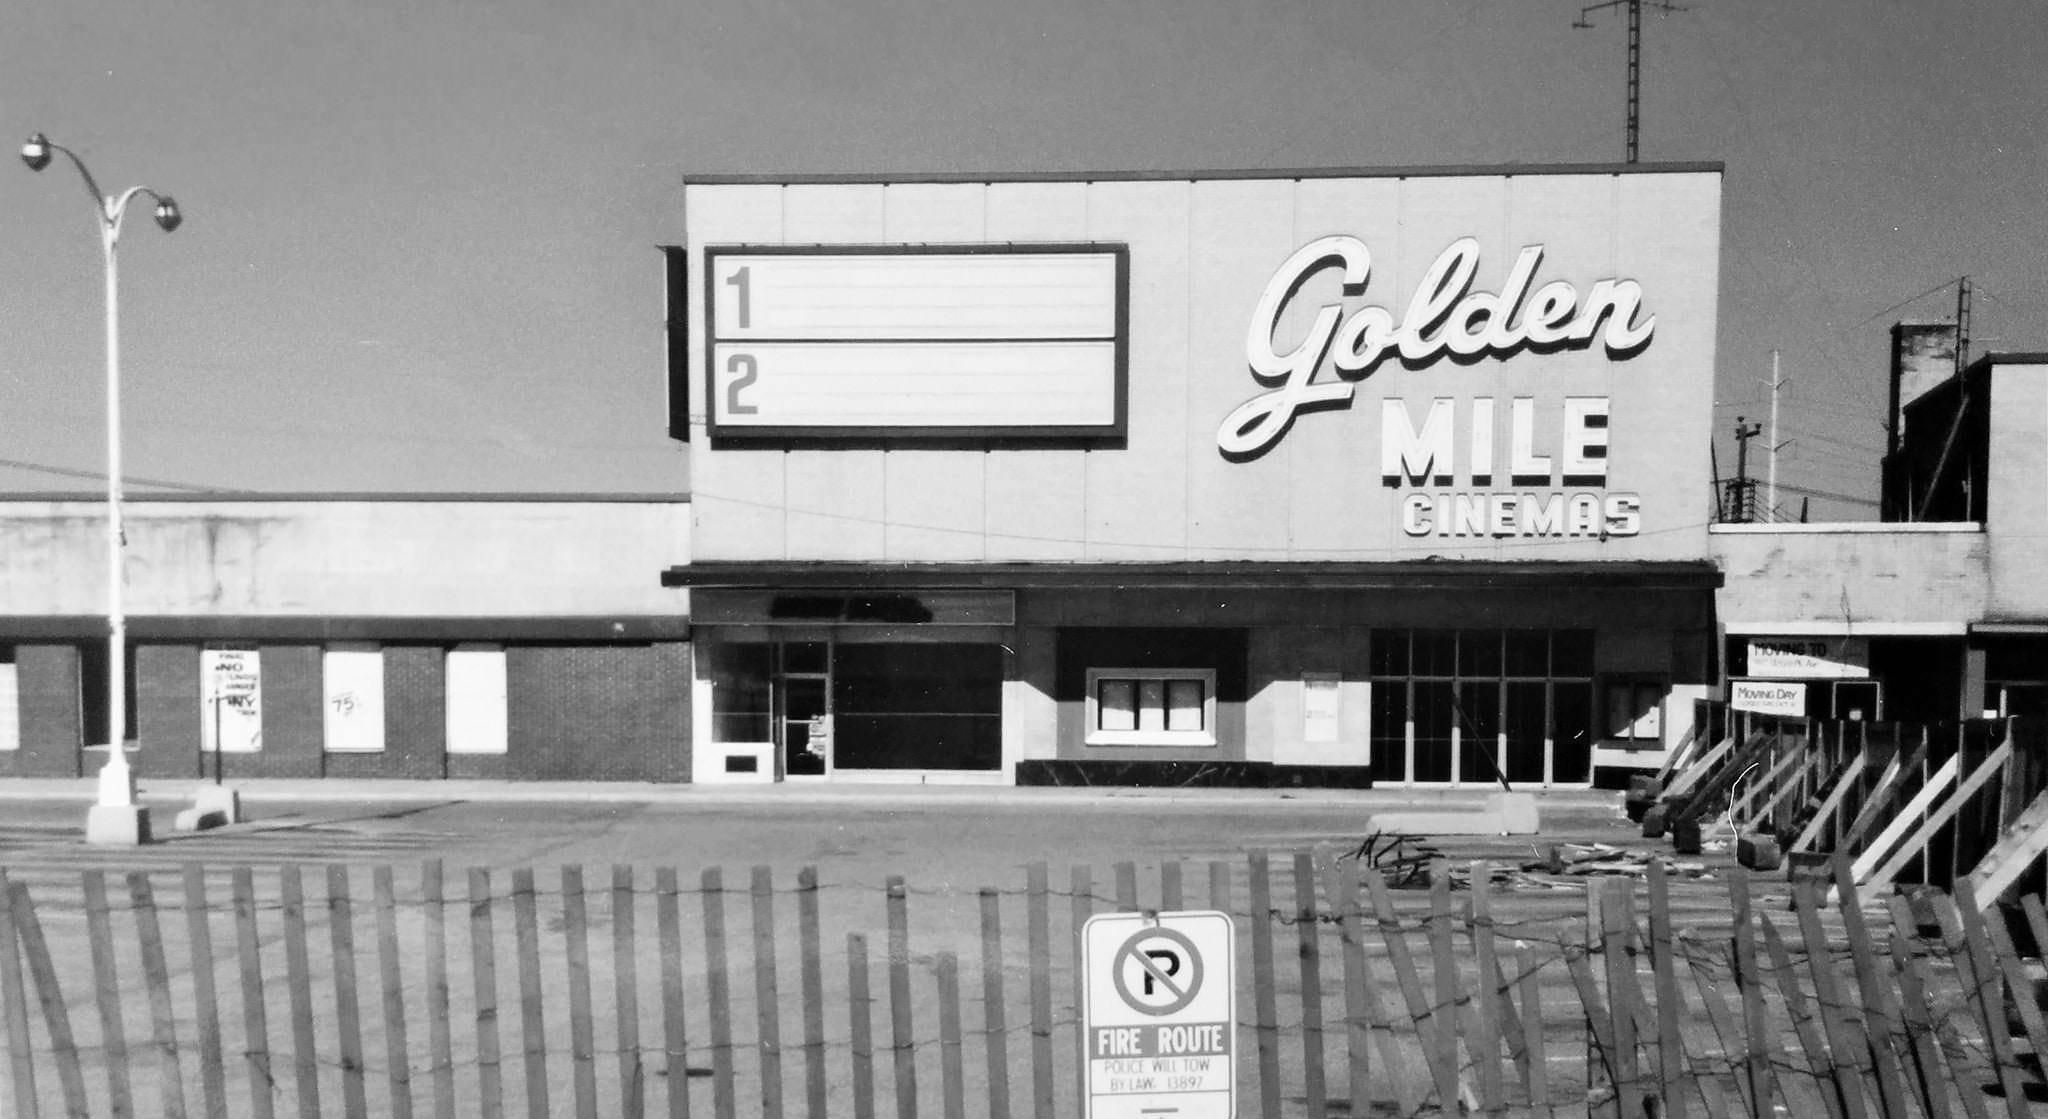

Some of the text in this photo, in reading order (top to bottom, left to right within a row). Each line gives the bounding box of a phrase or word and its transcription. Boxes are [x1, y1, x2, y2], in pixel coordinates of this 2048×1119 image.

[726, 266, 751, 329] 1
[1216, 234, 1655, 462] Golden
[727, 353, 758, 415] 2
[1382, 396, 1609, 487] MILE
[1403, 492, 1641, 538] CINEMAS
[1754, 642, 1826, 657] MOVING TO
[1098, 1024, 1224, 1056] FIRE ROUTE
[1104, 1058, 1211, 1074] POLICE WILL TOW
[1167, 1076, 1203, 1090] 13897
